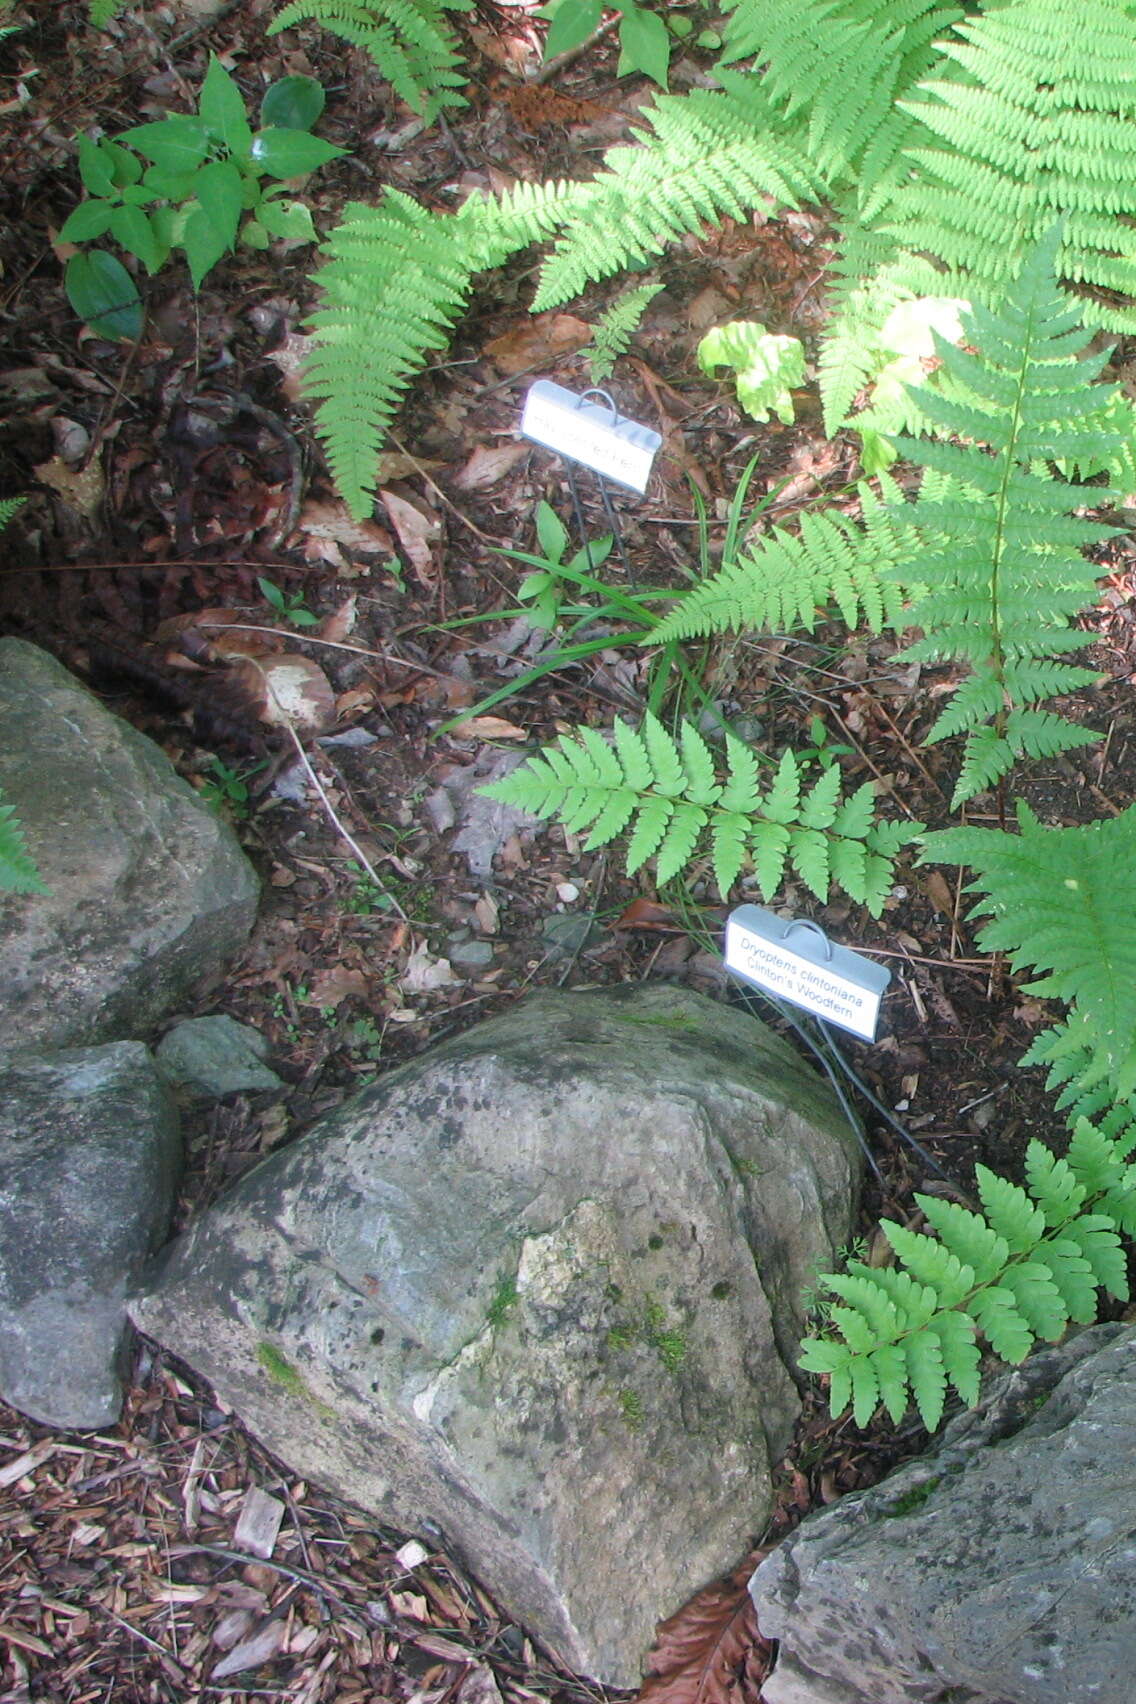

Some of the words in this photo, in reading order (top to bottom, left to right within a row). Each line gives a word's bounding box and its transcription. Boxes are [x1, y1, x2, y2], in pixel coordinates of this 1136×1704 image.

[747, 956, 793, 989] Clinton's
[796, 982, 853, 1019] Woodfern
[800, 969, 863, 1007] clintoniana
